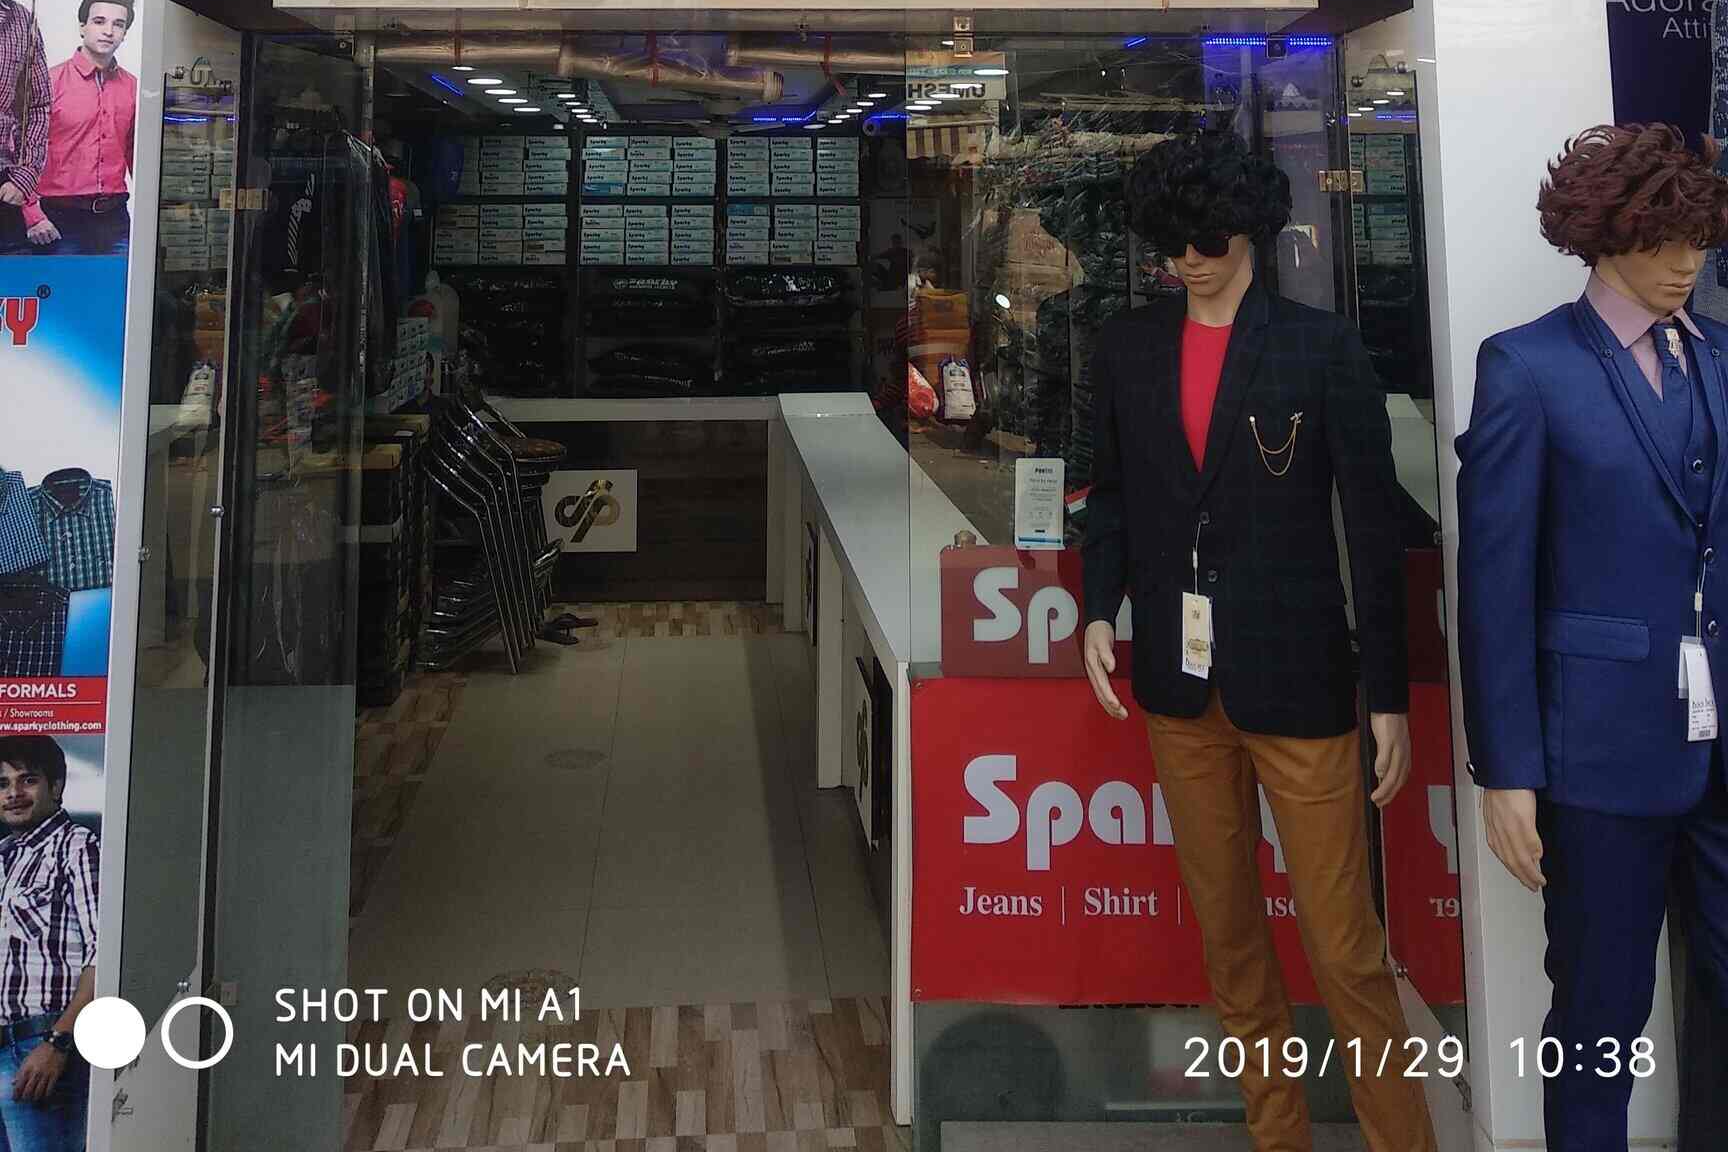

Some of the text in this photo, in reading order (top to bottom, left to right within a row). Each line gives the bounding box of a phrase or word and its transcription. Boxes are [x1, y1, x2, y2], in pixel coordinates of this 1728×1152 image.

[0, 683, 77, 698] FORMALS
[959, 886, 1159, 917] Jeans Shirt
